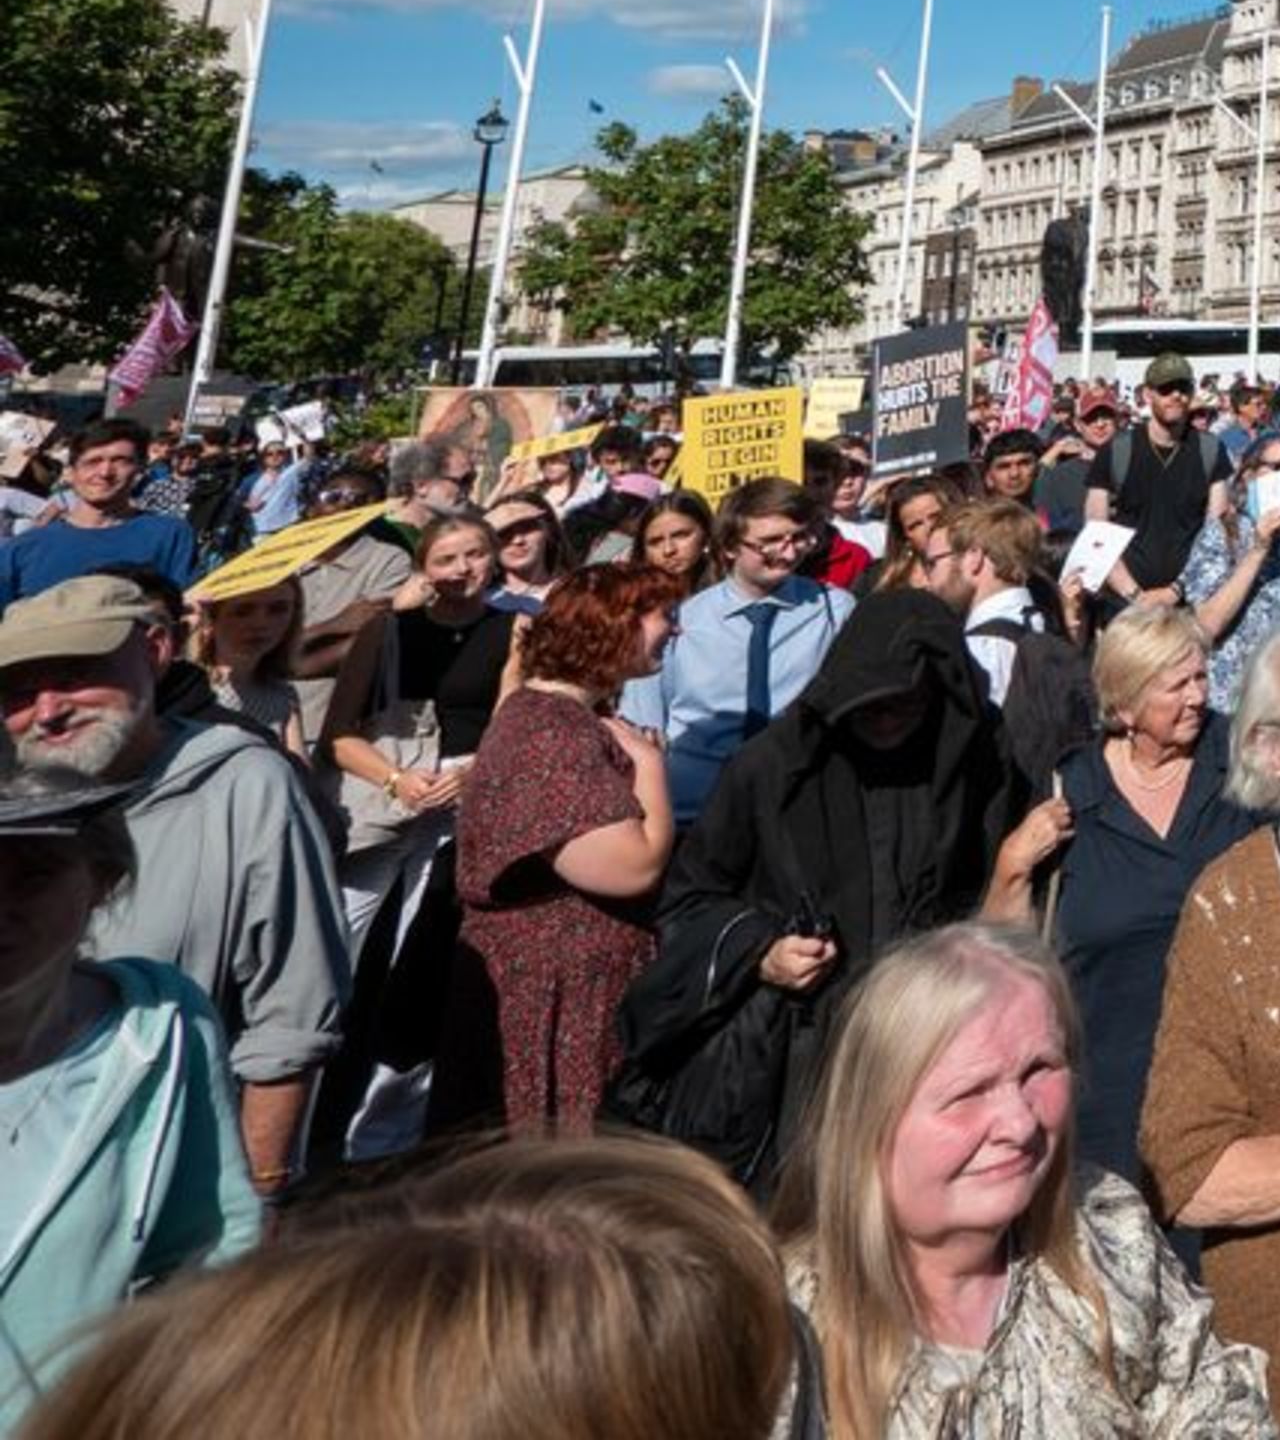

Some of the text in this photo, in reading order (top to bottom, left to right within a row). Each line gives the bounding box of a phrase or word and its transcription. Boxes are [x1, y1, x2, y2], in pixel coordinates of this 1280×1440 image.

[880, 349, 964, 387] ABORTION
[878, 374, 961, 412] HURTS THE
[702, 399, 785, 426] HUMAN
[877, 402, 940, 437] FAMILY
[702, 420, 785, 448] RIGHTS
[705, 473, 728, 493] IN
